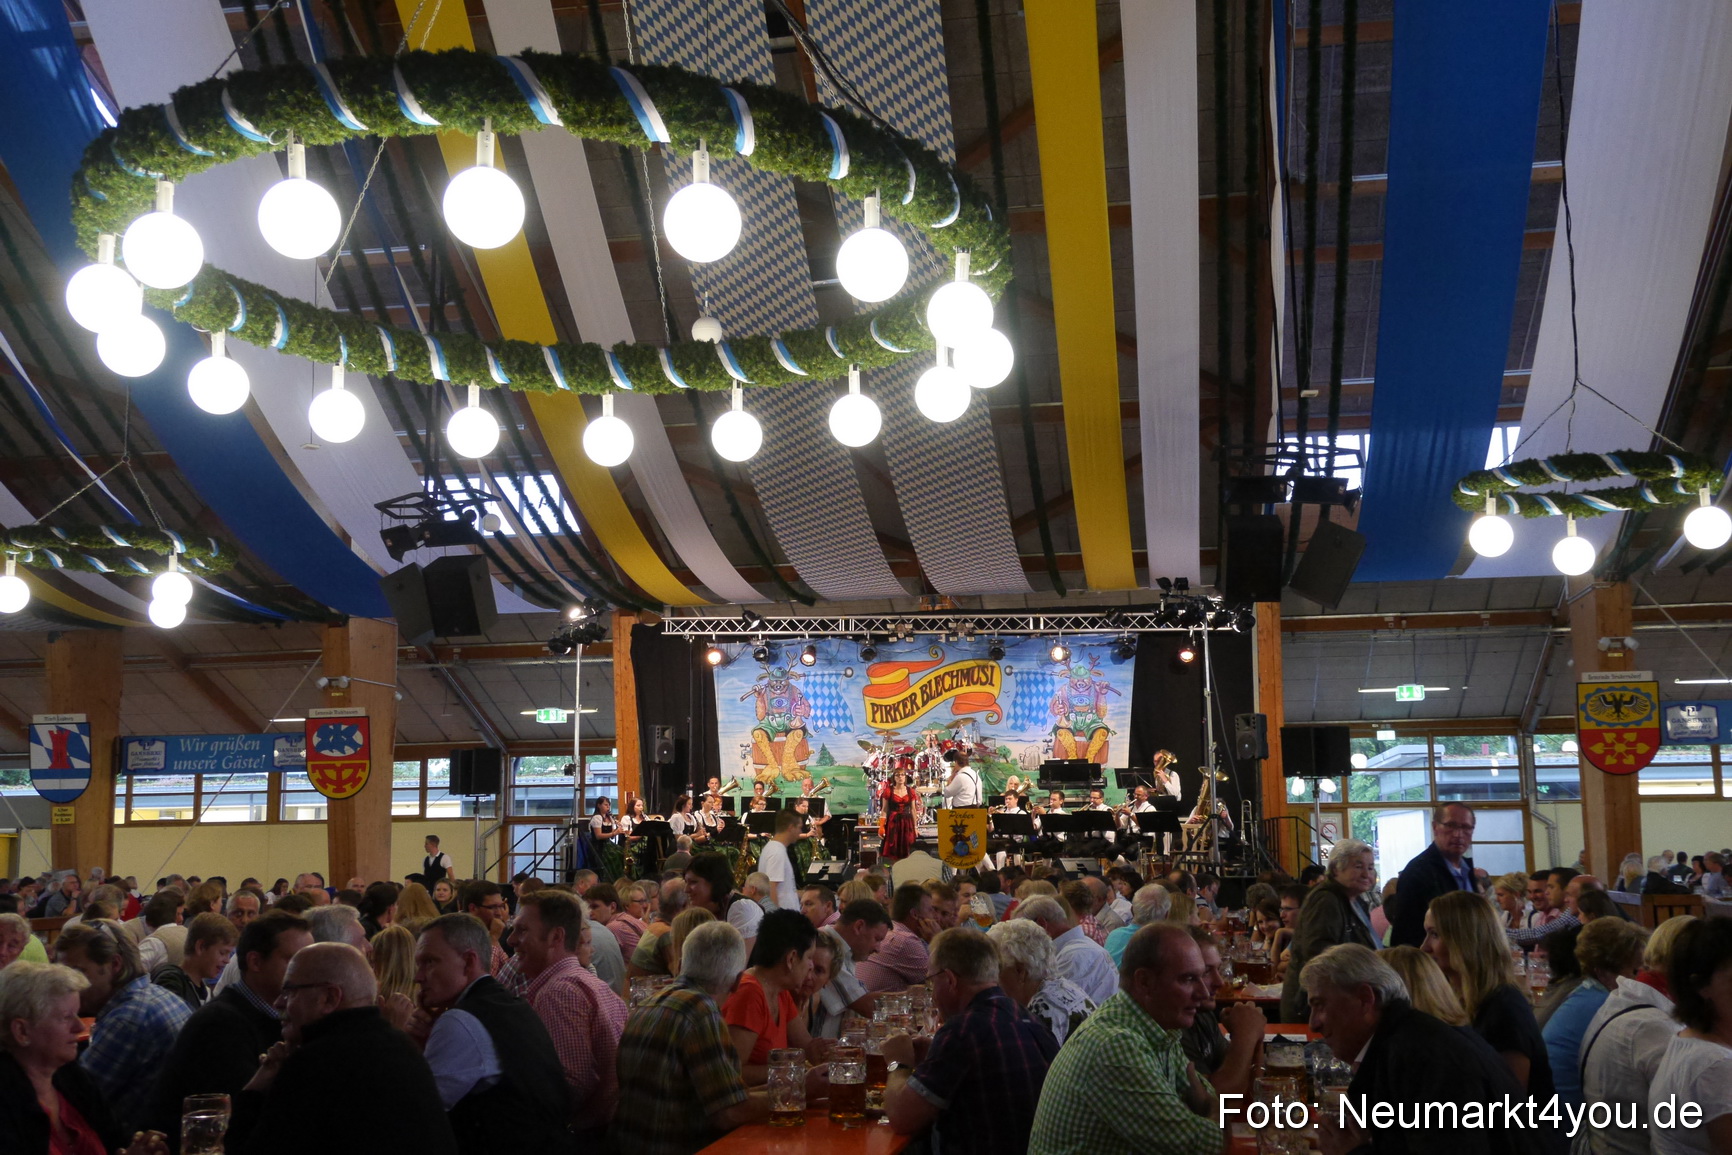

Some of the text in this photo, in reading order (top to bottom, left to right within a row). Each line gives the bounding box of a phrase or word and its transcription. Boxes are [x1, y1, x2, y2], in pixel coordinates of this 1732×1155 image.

[870, 665, 996, 724] PIRKER BLECHMUSI
[179, 735, 260, 758] Wir grüßen
[173, 758, 217, 771] unsere
[221, 754, 266, 771] Gäste!
[948, 810, 975, 820] Pirker
